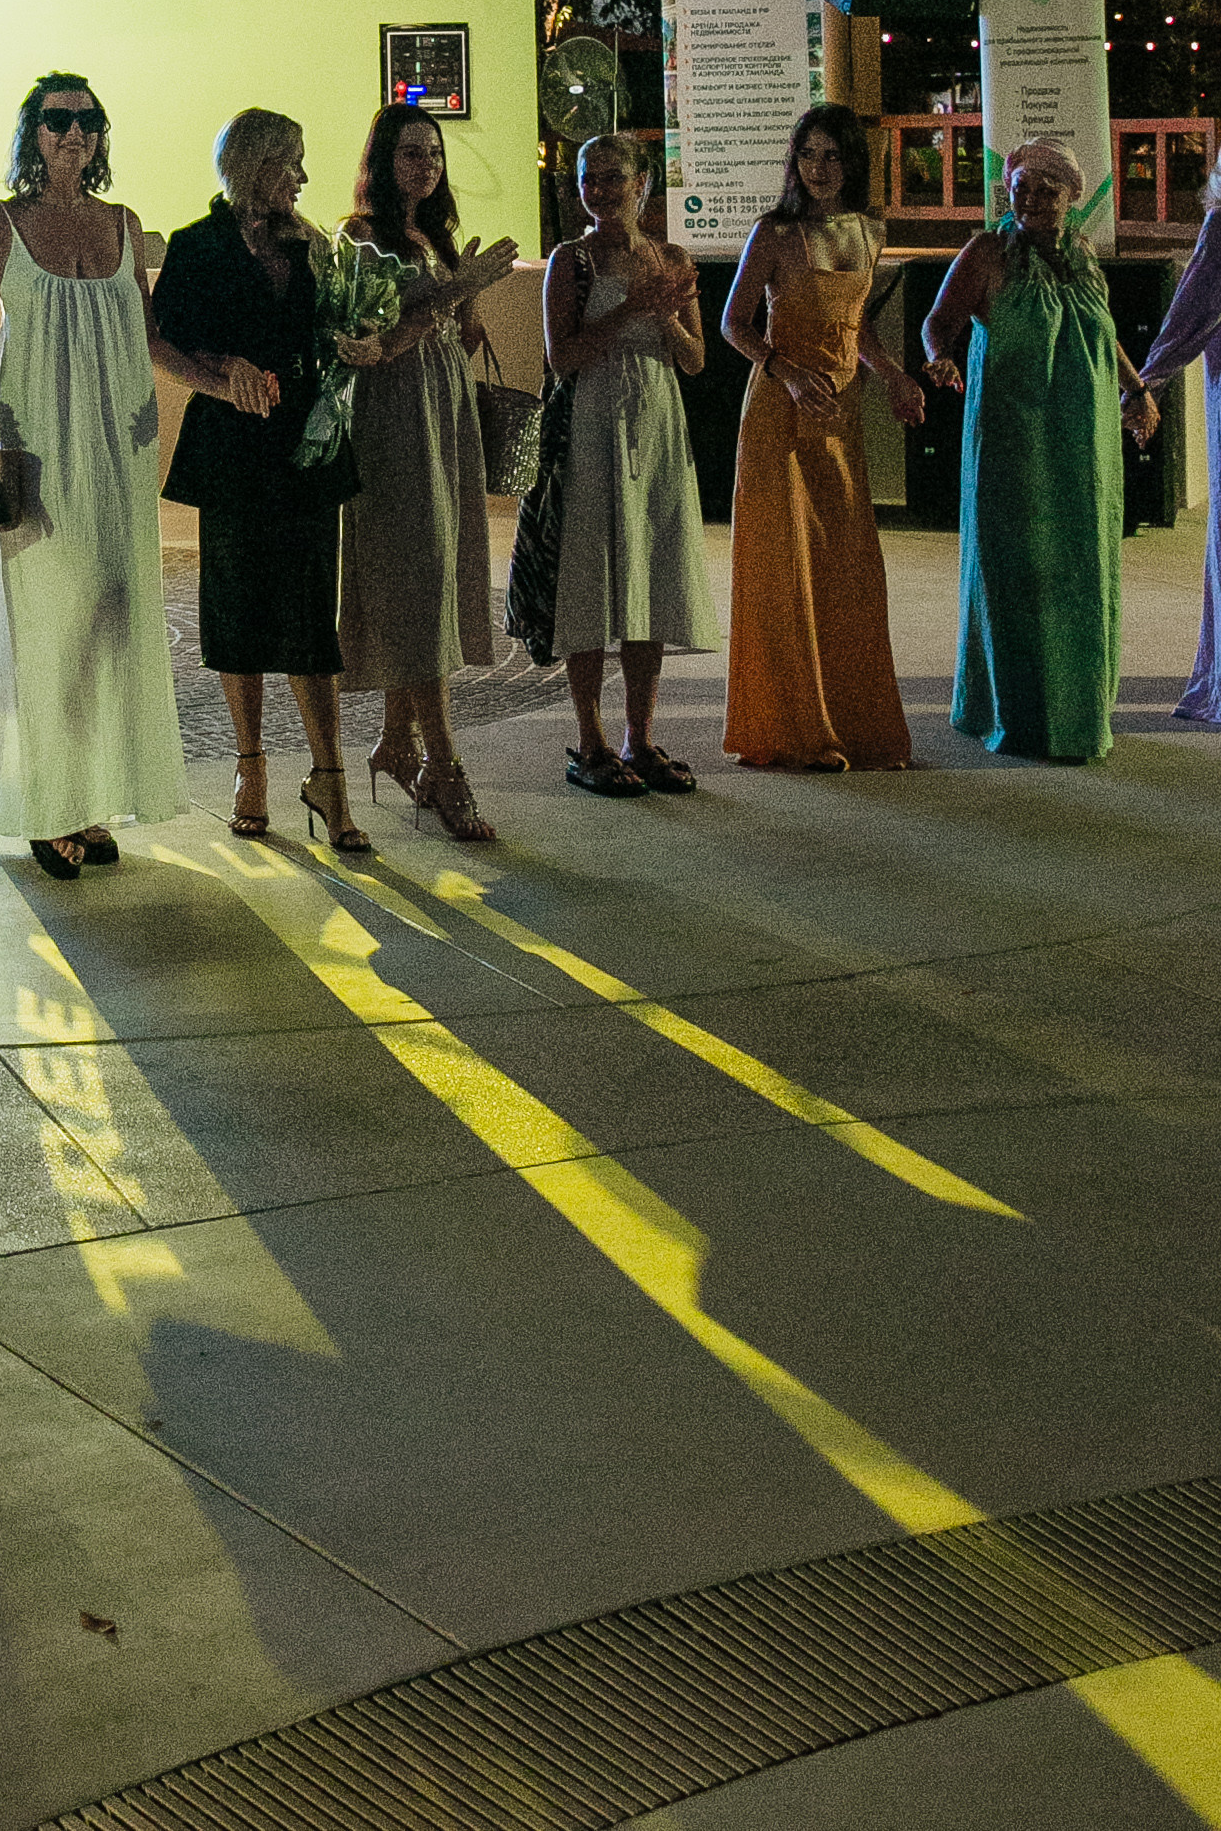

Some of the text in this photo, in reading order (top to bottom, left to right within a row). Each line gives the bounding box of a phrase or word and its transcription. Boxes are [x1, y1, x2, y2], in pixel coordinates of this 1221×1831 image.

[691, 21, 719, 29] АРЕНДА
[748, 40, 776, 48] ОТЕЛЕЙ
[1021, 100, 1059, 111] Покупка
[1021, 114, 1055, 126] Аренда
[694, 125, 760, 133] ИНДИВИДУАЛЬНЫЕ
[694, 140, 723, 148] АРЕНДА
[708, 196, 724, 204] +66
[726, 196, 738, 204] 85
[740, 195, 757, 203] 888
[708, 205, 724, 214] +66
[726, 205, 737, 213] 81
[740, 205, 757, 213] 295
